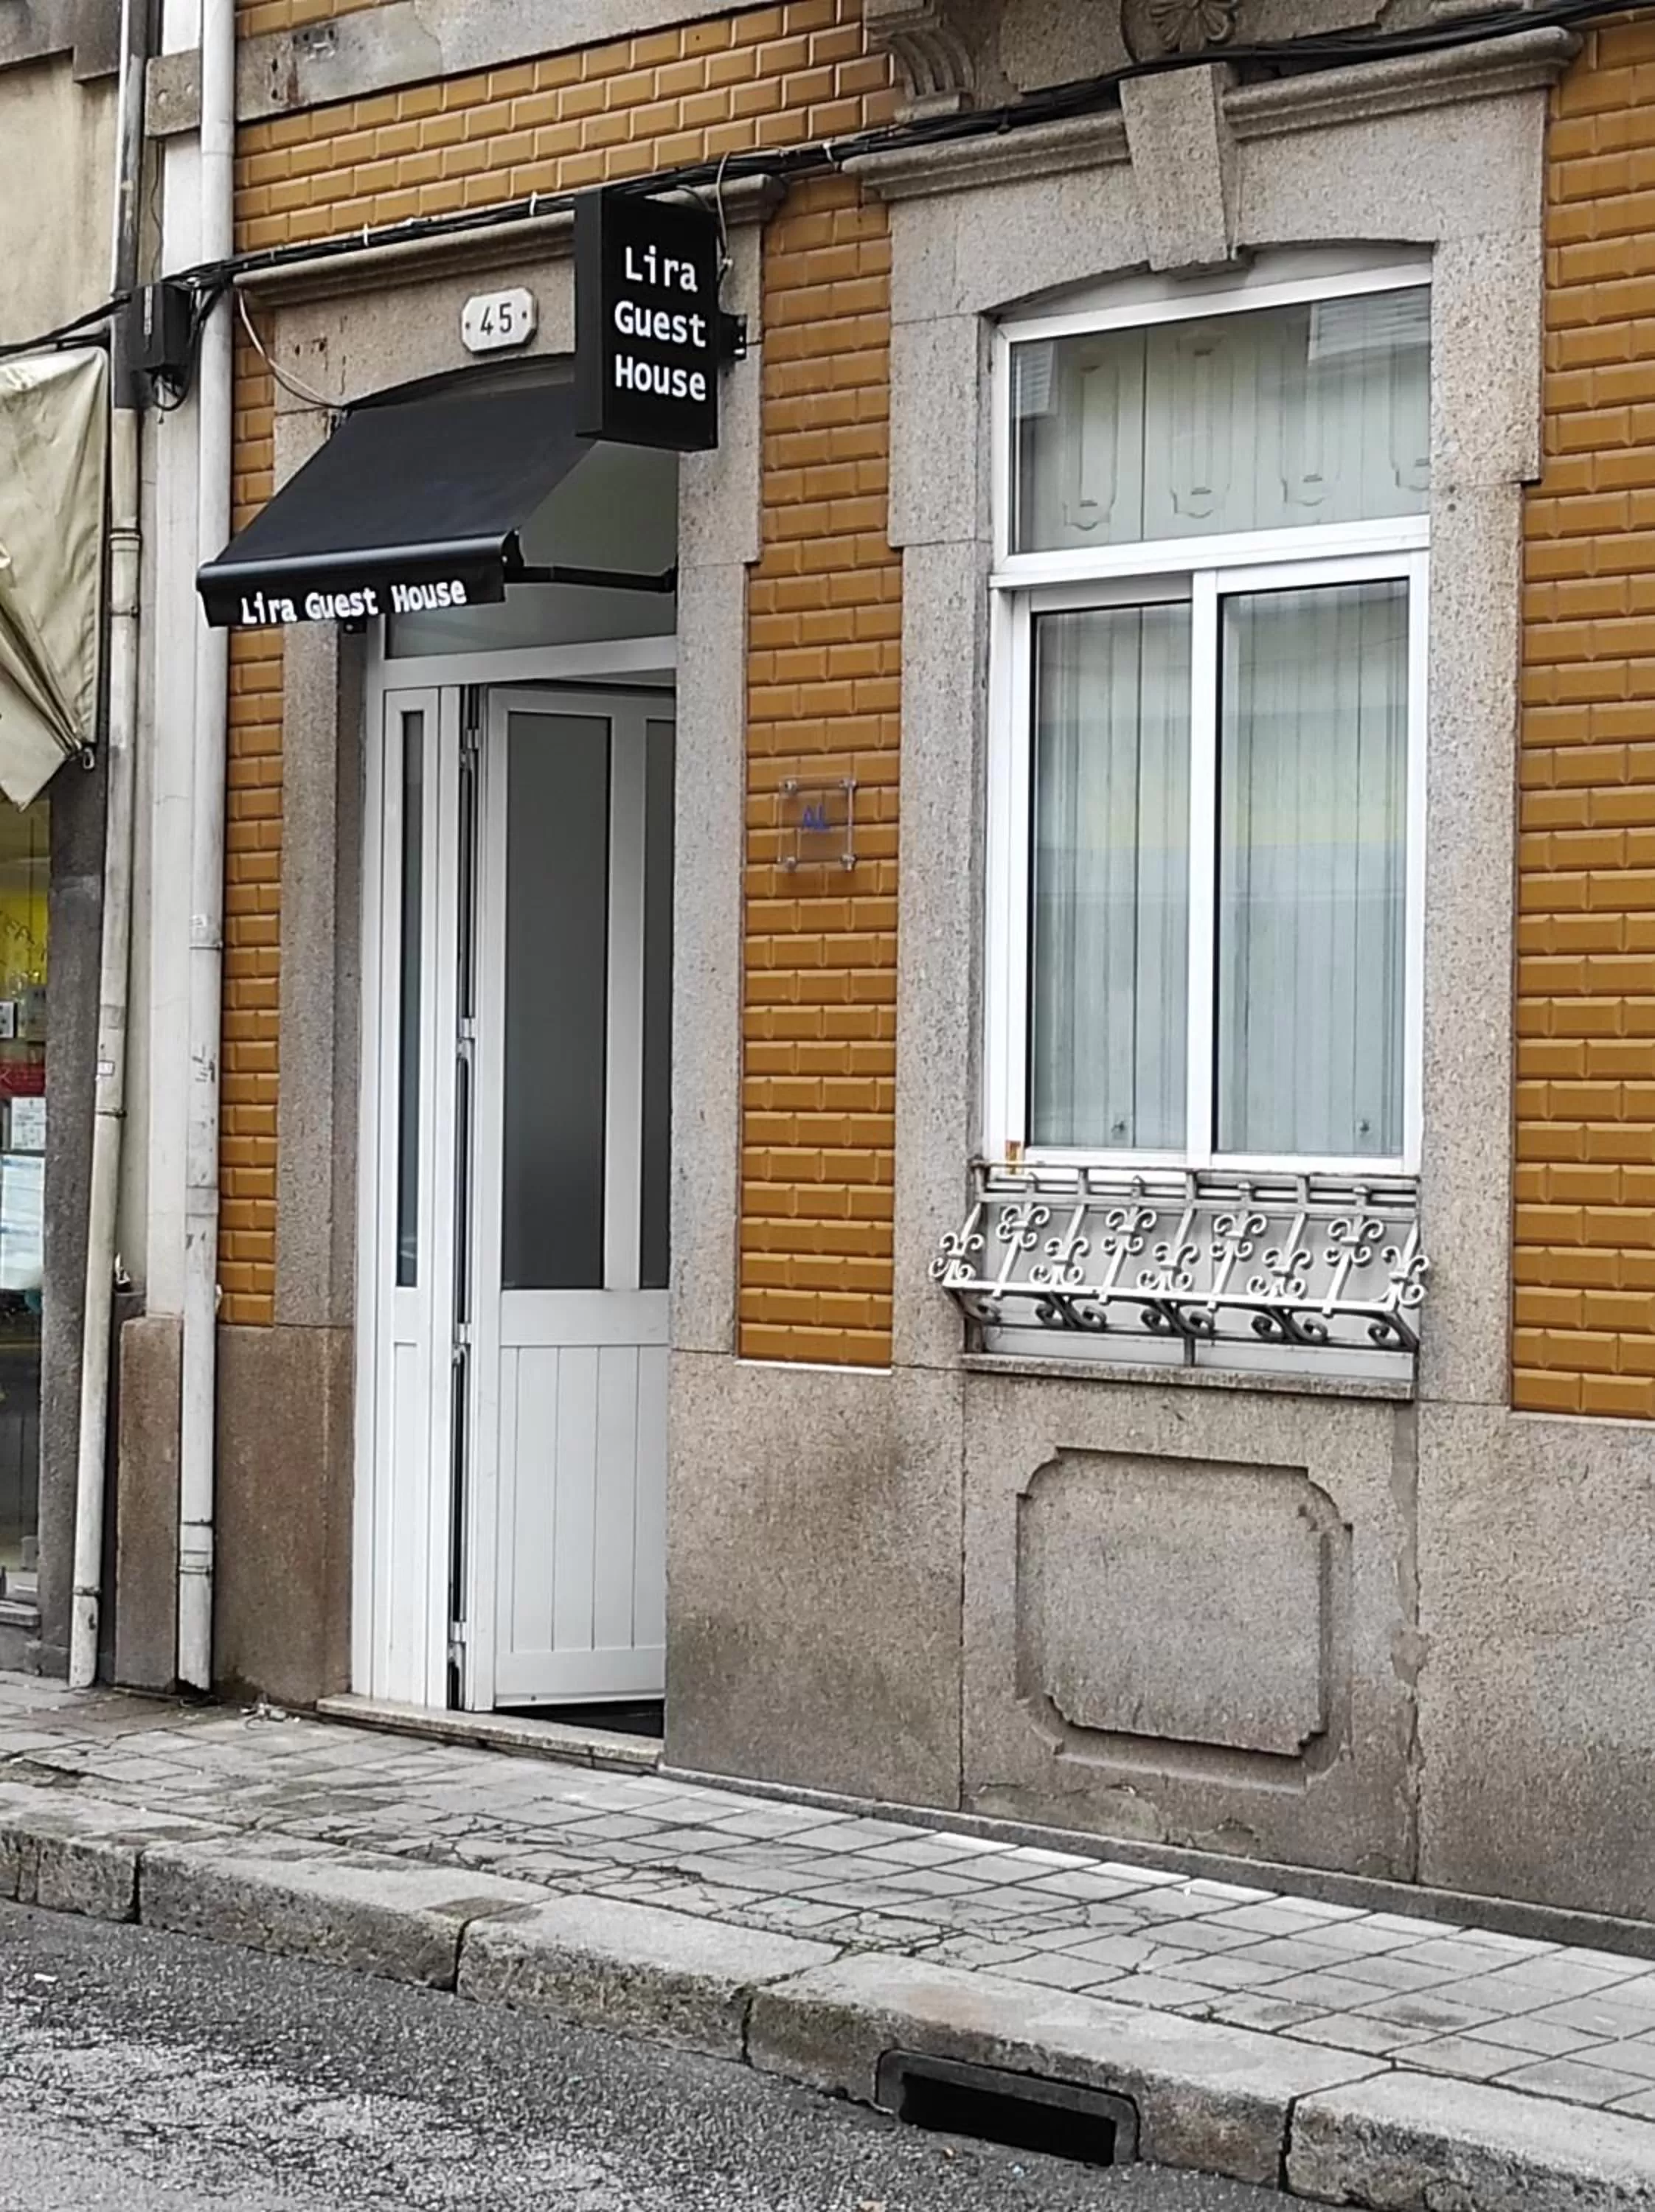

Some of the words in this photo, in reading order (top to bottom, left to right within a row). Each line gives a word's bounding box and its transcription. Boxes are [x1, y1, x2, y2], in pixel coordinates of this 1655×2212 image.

[625, 245, 698, 292] Lira
[480, 302, 513, 335] 45
[614, 300, 707, 348] Guest
[614, 354, 707, 401] House
[241, 592, 296, 625] Lira
[305, 588, 378, 620] Guest
[391, 580, 468, 613] House
